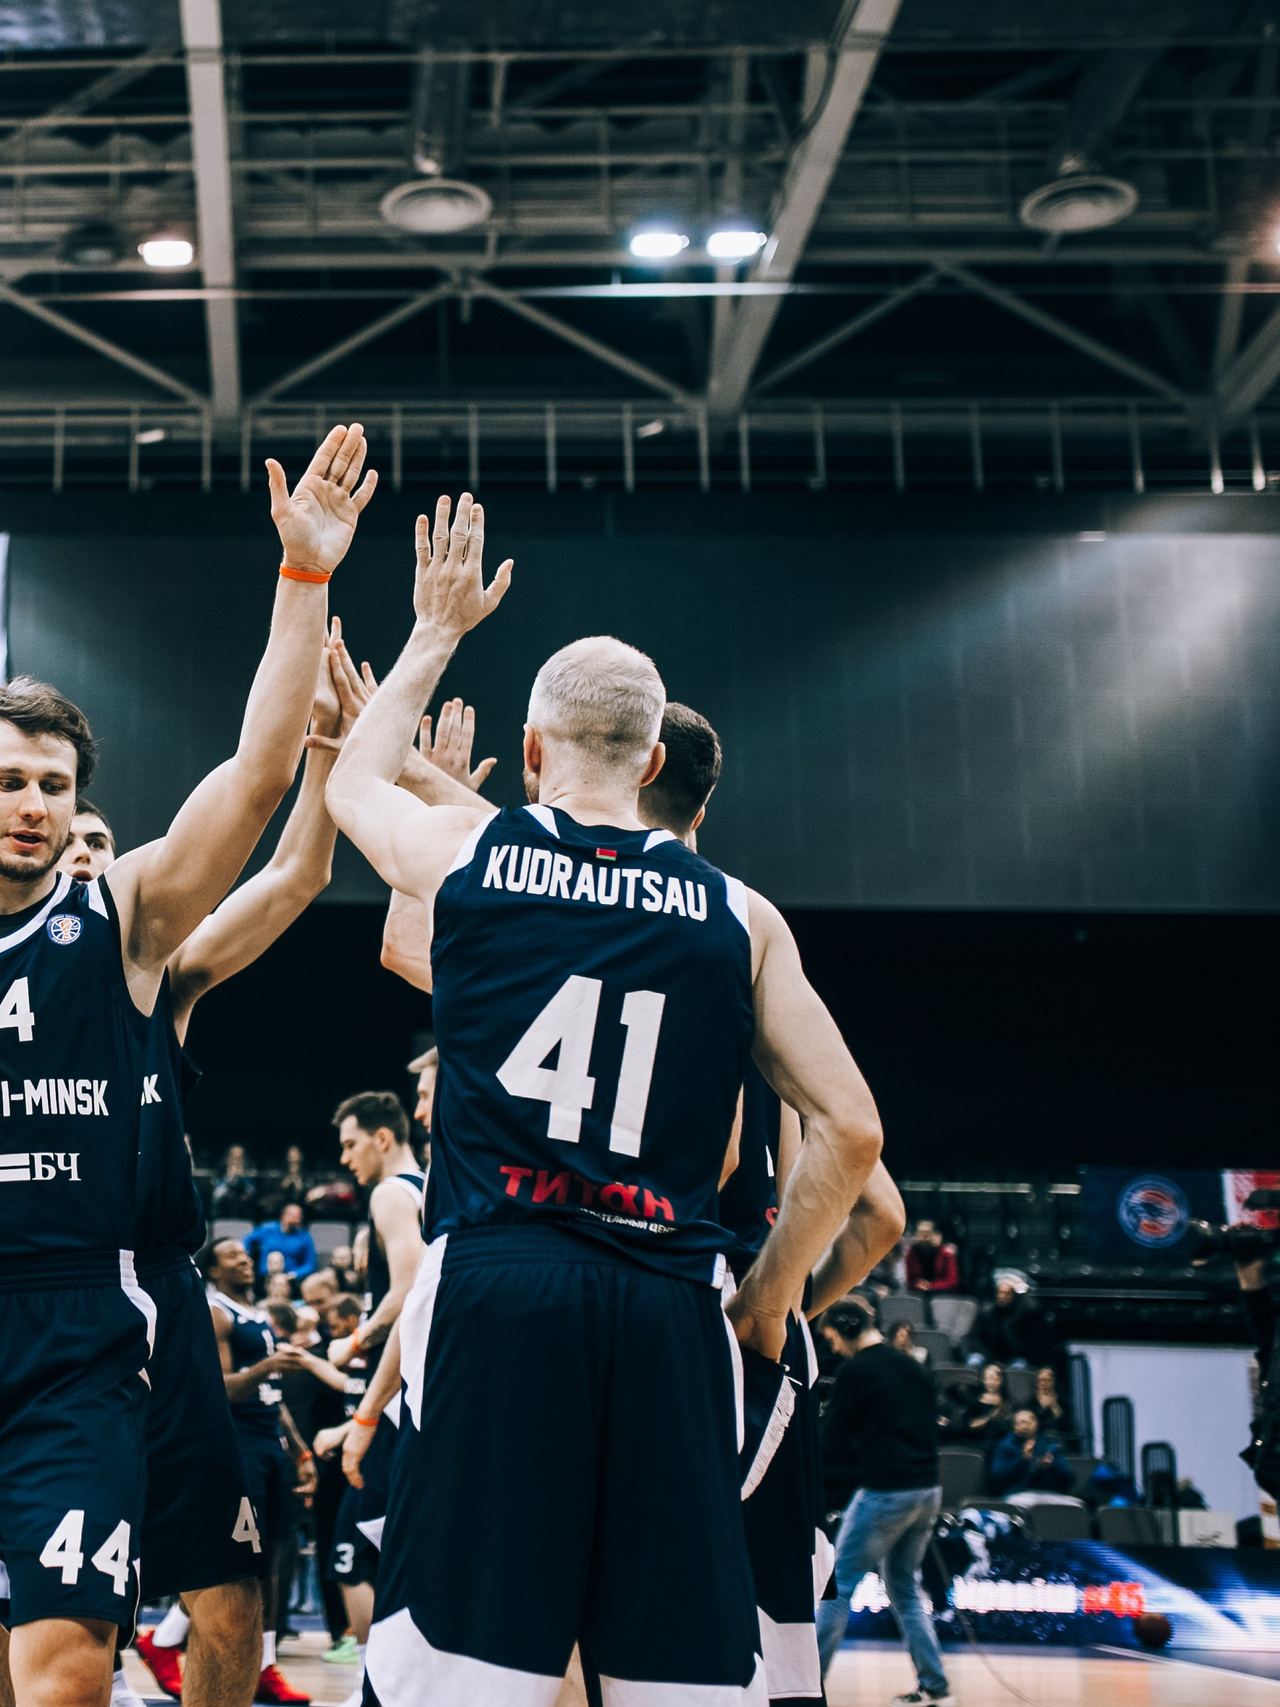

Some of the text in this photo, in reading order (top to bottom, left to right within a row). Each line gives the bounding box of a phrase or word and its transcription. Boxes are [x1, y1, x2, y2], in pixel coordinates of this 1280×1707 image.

[482, 845, 707, 921] KUDRAUTSAU
[495, 975, 666, 1158] 41
[31, 1153, 81, 1181] БЧ
[39, 1510, 131, 1596] 44
[231, 1497, 262, 1553] 4
